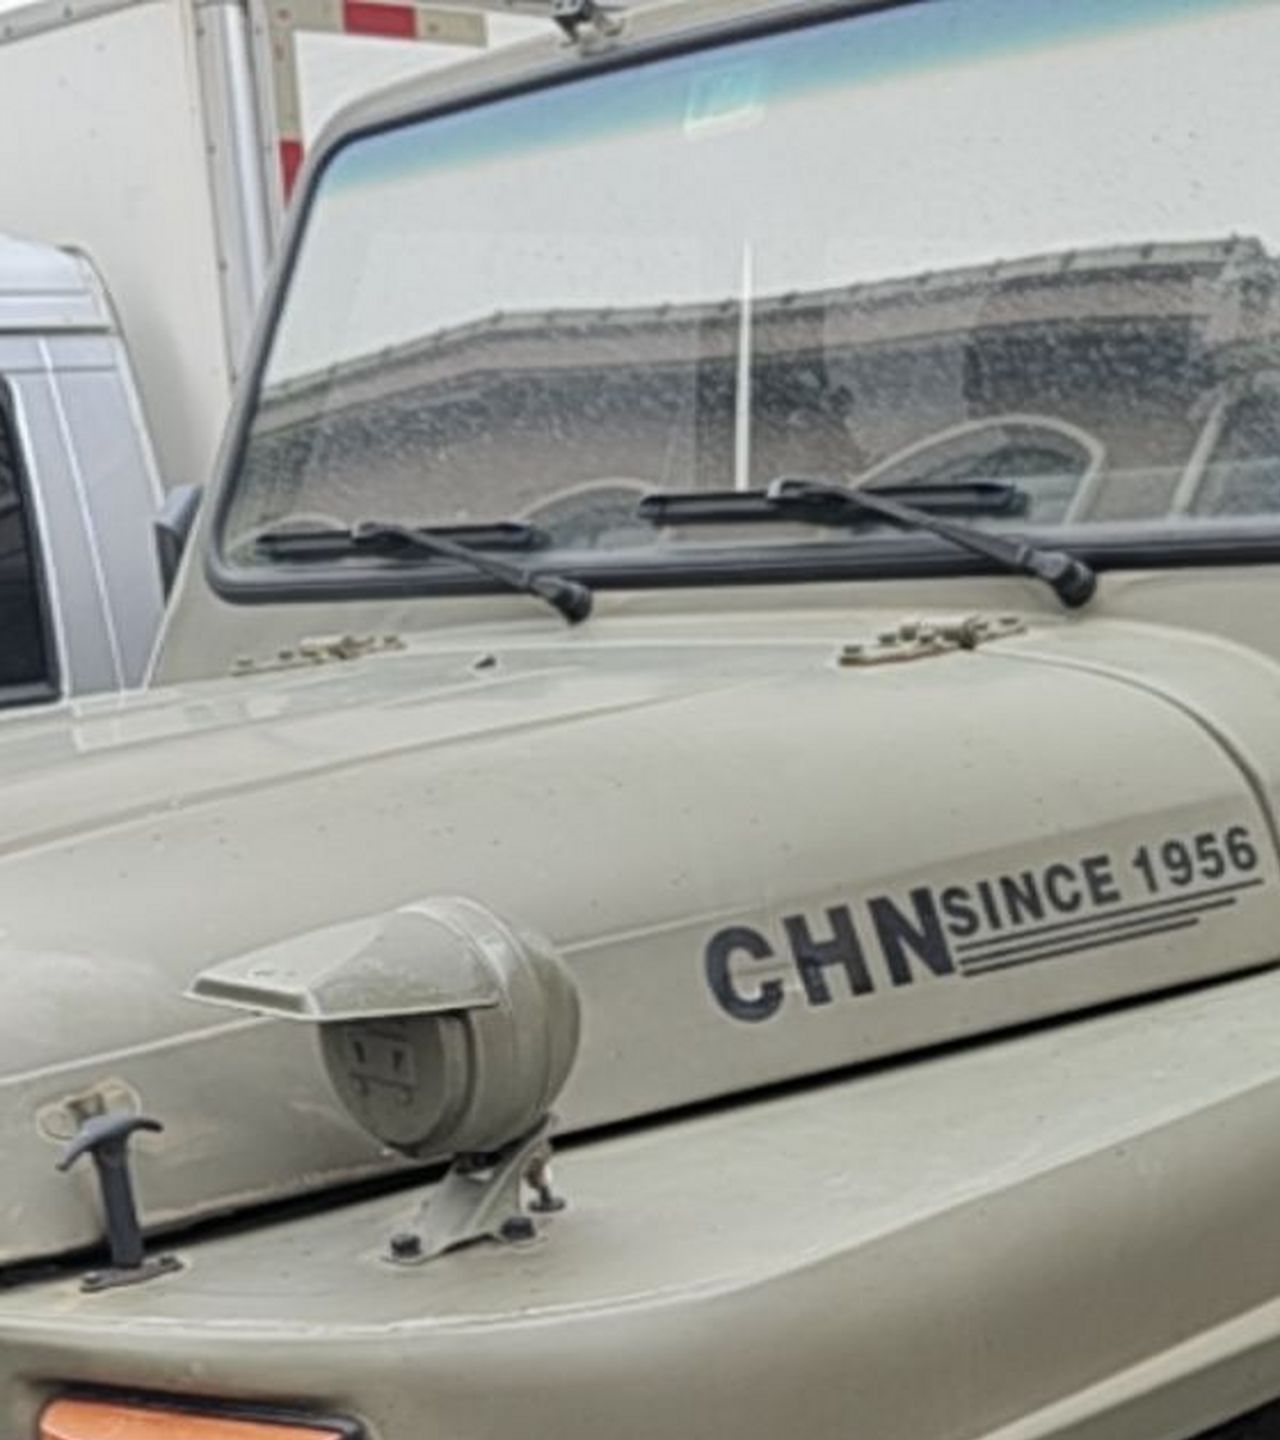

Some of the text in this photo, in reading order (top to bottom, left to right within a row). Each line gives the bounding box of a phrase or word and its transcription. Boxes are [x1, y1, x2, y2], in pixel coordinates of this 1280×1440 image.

[704, 825, 1258, 1022] CHN SINCE 1956
